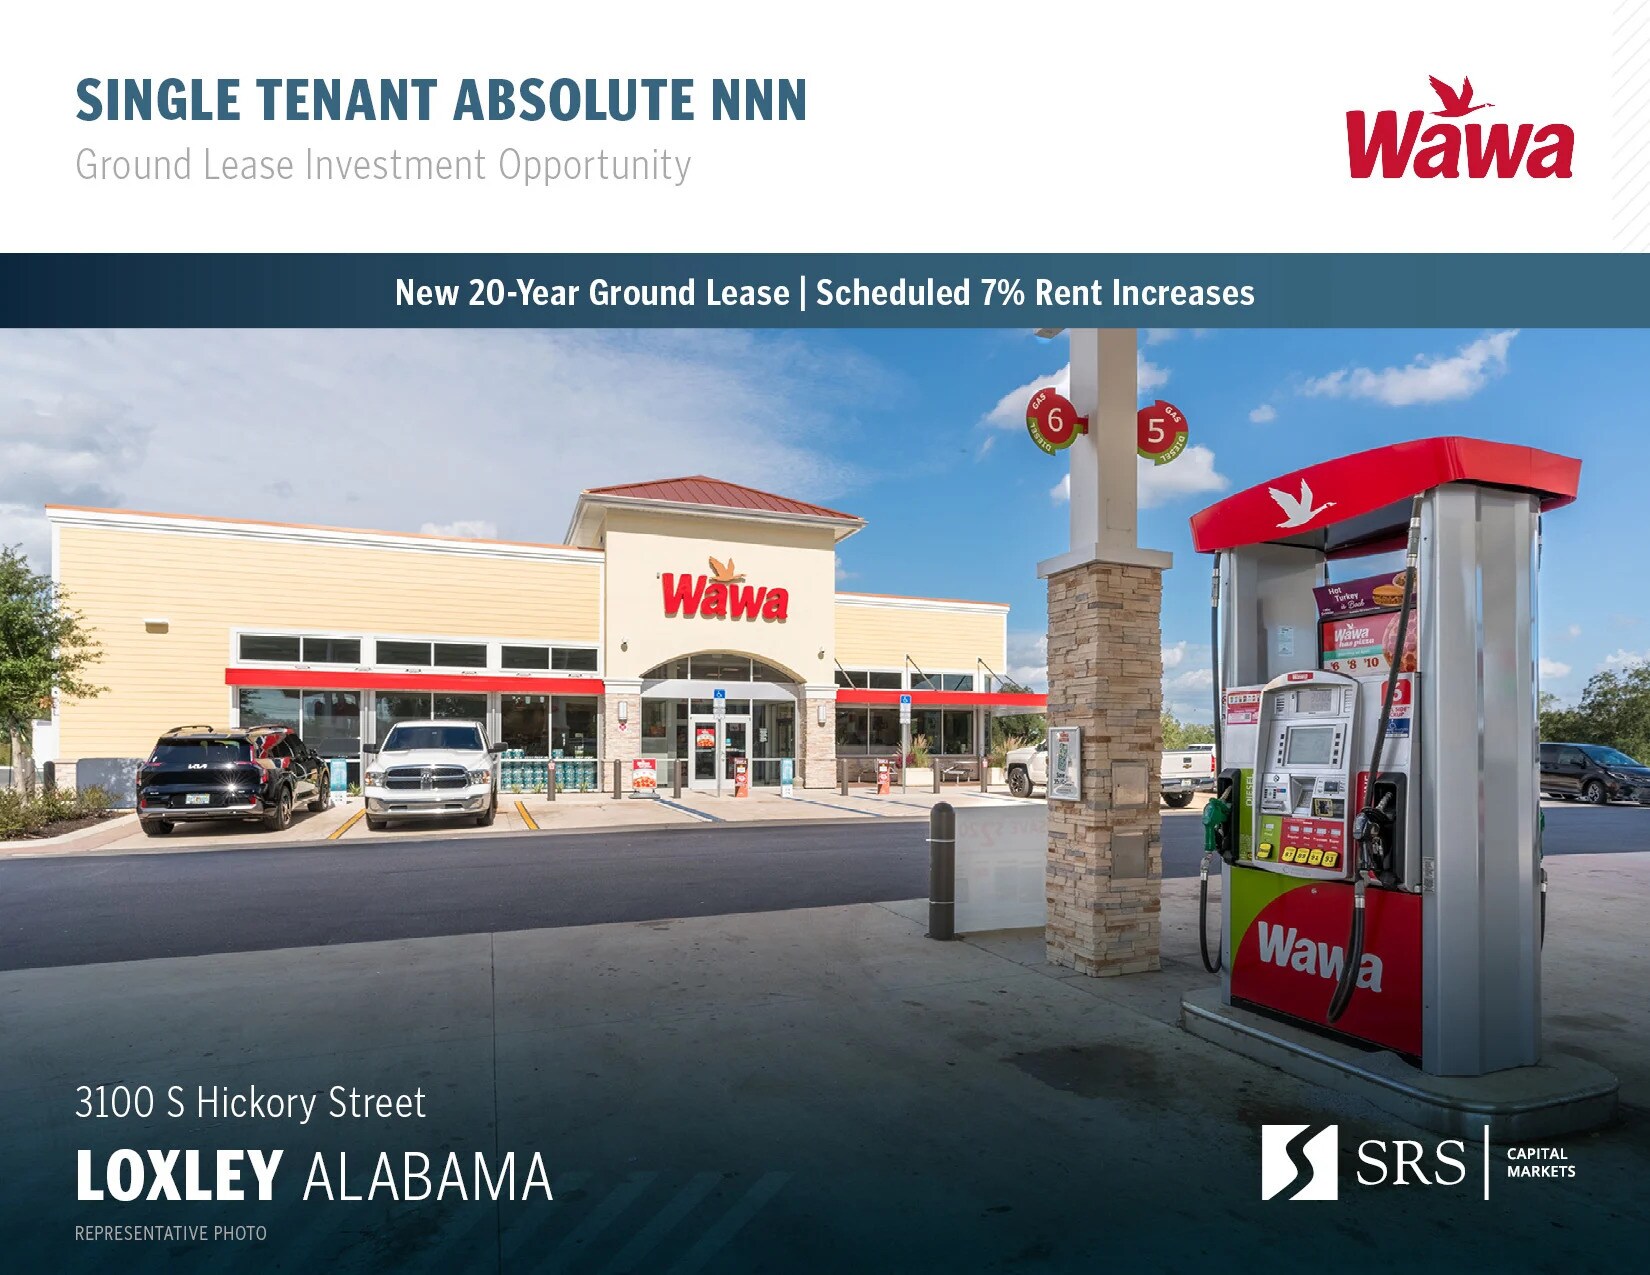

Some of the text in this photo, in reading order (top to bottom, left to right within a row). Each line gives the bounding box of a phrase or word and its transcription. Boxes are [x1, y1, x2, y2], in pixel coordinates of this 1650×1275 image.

[1032, 393, 1047, 410] GAS
[1048, 408, 1063, 433] 6
[1165, 407, 1181, 423] GAS
[1030, 422, 1052, 451] DIESEL
[1148, 418, 1165, 443] 5
[1160, 435, 1186, 462] DIESEL
[662, 573, 789, 623] Wawa
[1328, 587, 1342, 595] Hot
[1334, 593, 1359, 602] Turkey
[1335, 627, 1370, 643] Wawa
[1353, 638, 1375, 648] pizza
[1364, 657, 1380, 668] $10
[1258, 920, 1384, 993] Wawa
